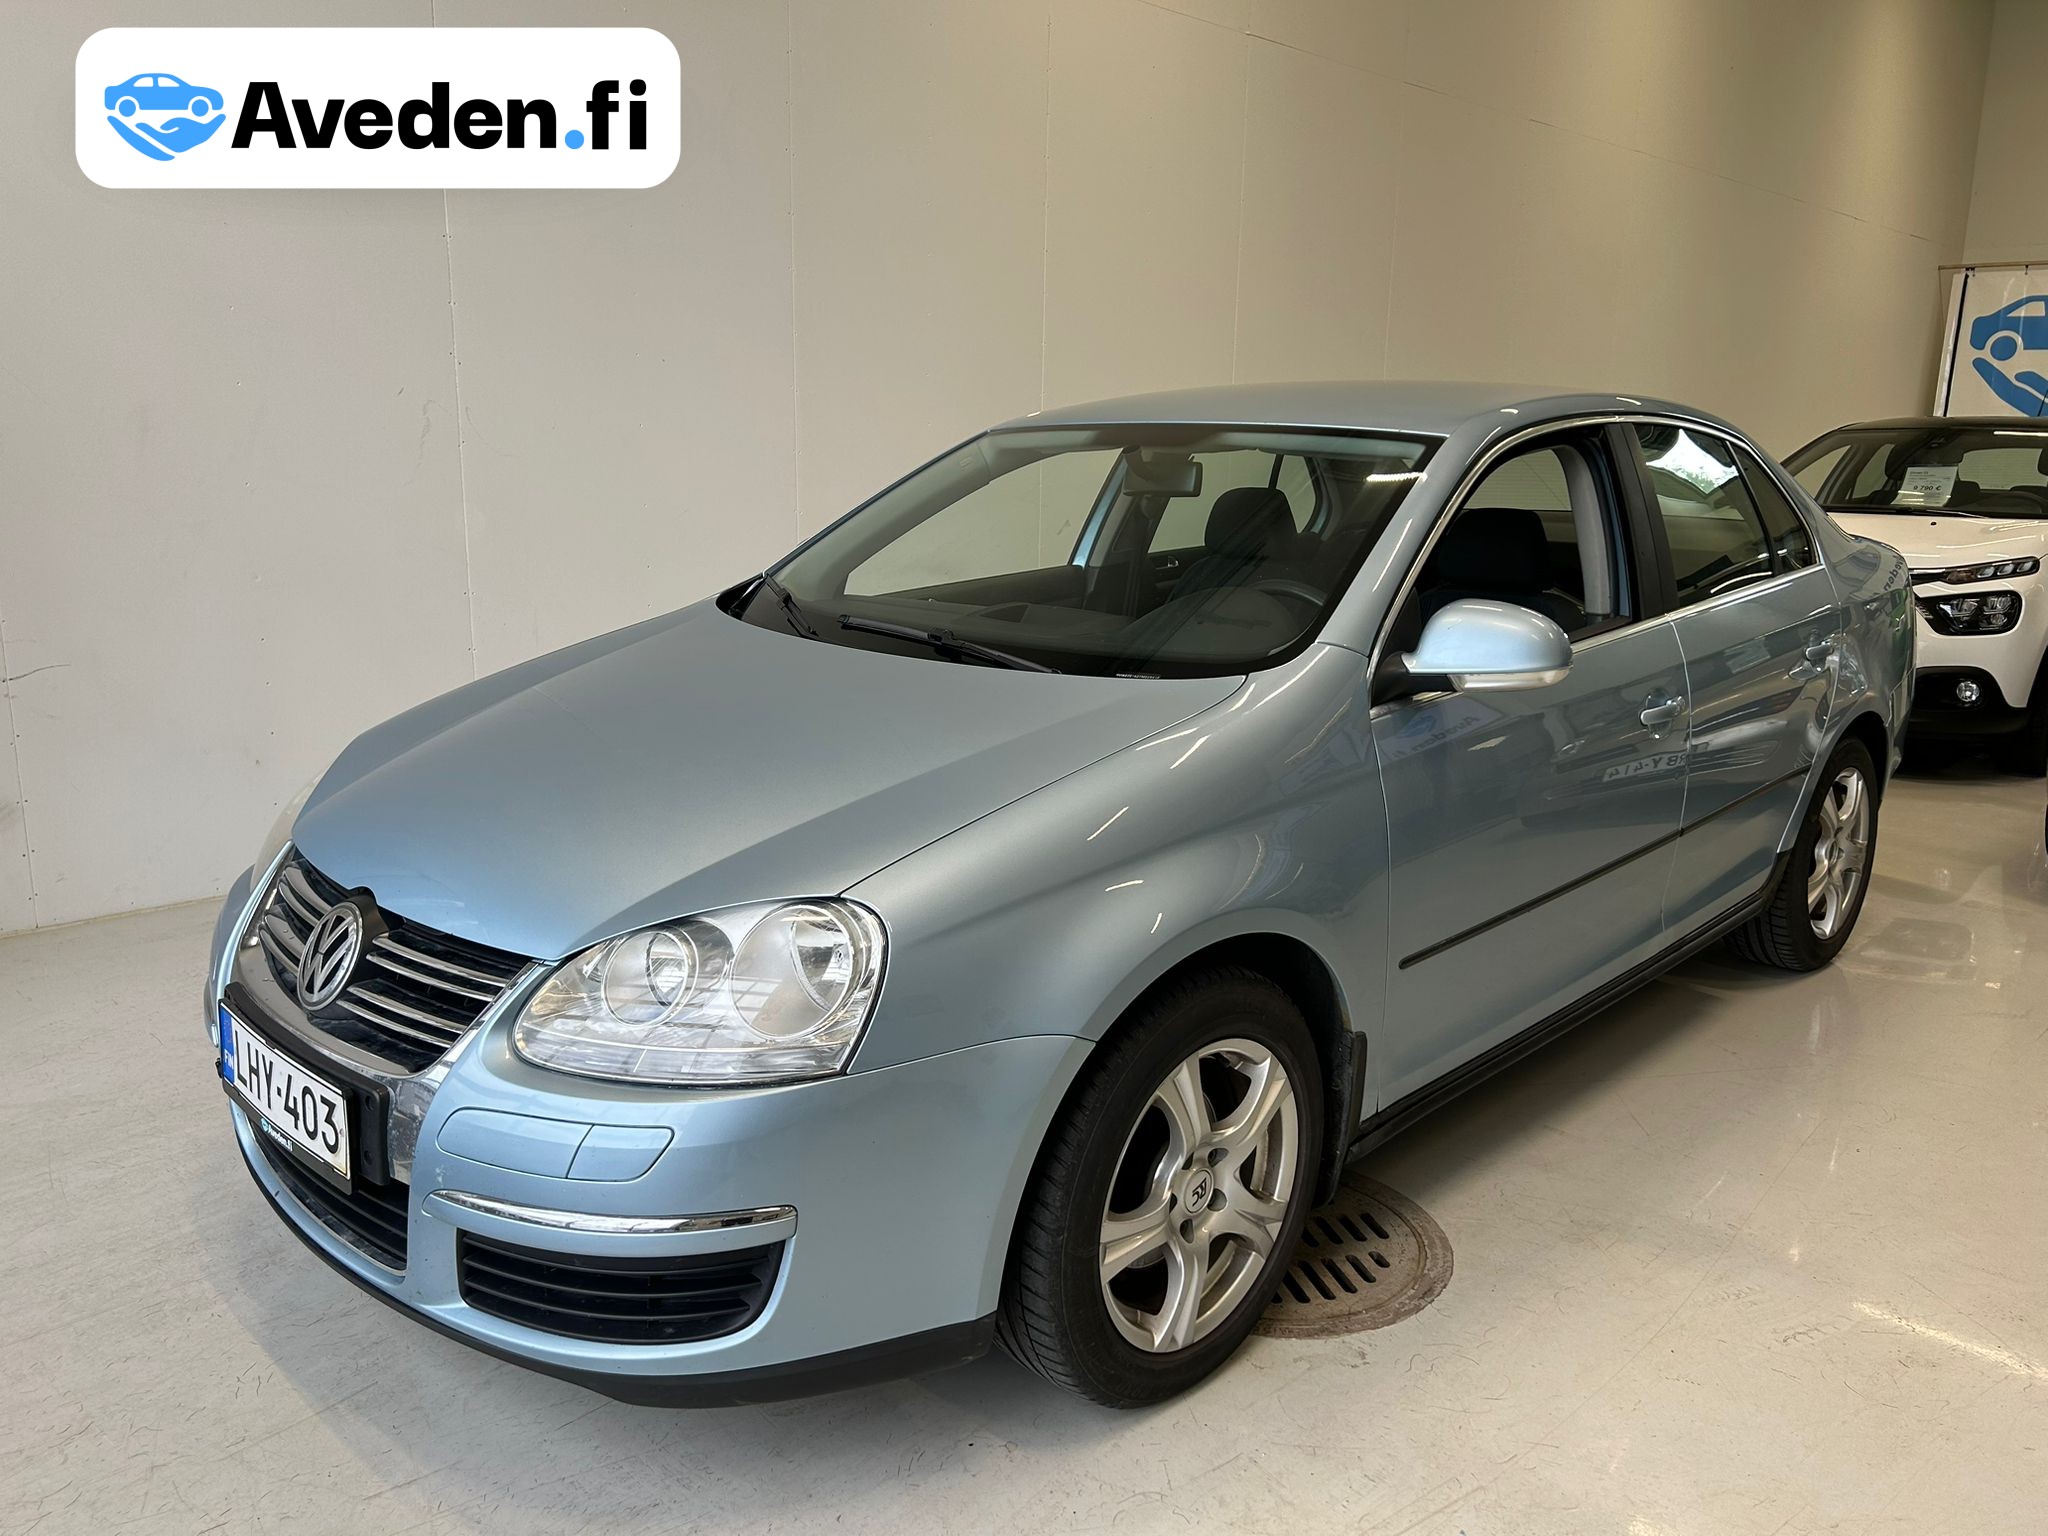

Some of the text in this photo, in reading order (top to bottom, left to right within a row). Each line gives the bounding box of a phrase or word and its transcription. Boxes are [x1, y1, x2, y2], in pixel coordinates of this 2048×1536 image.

[224, 1048, 234, 1070] FIN
[234, 1029, 339, 1155] LHY-403
[1192, 1177, 1207, 1207] RC
